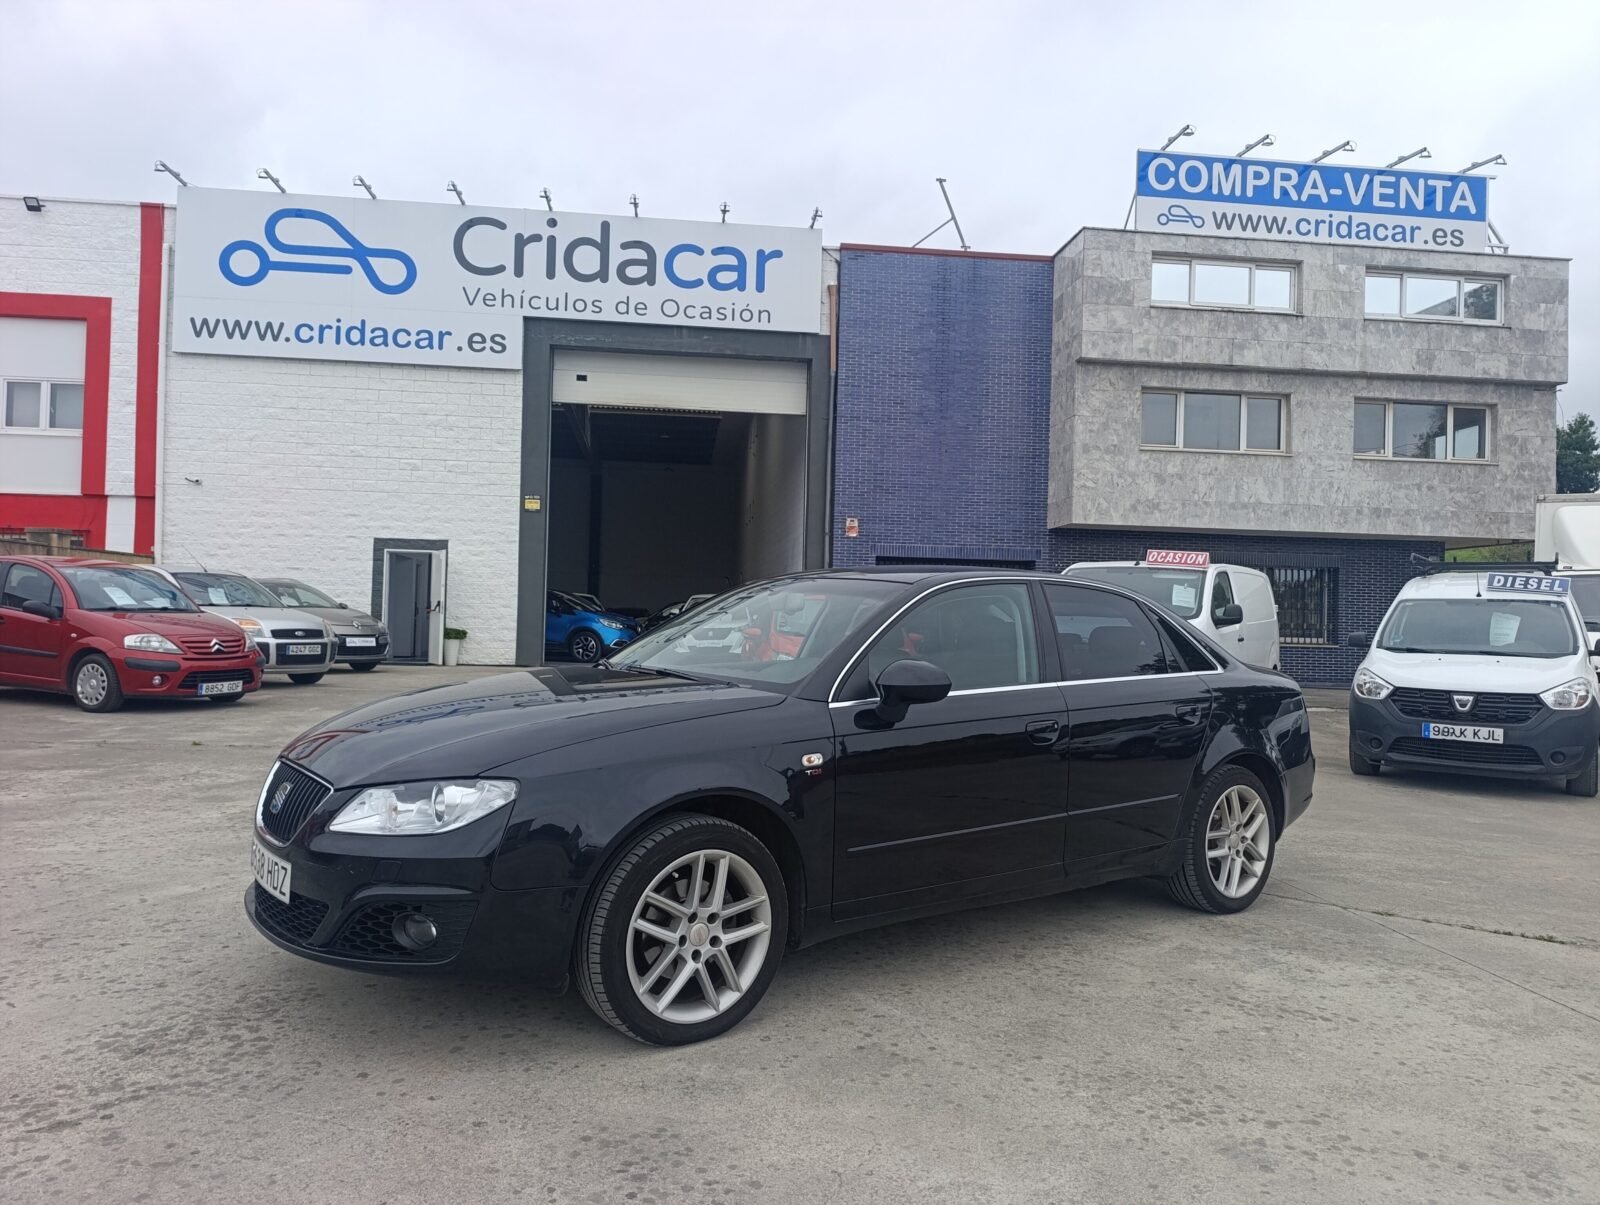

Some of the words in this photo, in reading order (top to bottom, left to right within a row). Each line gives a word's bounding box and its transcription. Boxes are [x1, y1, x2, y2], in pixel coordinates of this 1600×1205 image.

[1148, 157, 1476, 214] COMPRA-VENTA
[1212, 210, 1465, 247] www.cridacar.es
[453, 216, 783, 293] Cridacar
[462, 286, 603, 313] Vehículos
[615, 296, 648, 316] de
[660, 299, 772, 324] Ocasión
[190, 316, 507, 354] www.cridacar.es
[1149, 552, 1205, 564] OCASION
[1493, 576, 1563, 591] DIESEL
[1473, 729, 1500, 741] KJL
[266, 857, 288, 896] HDZ
